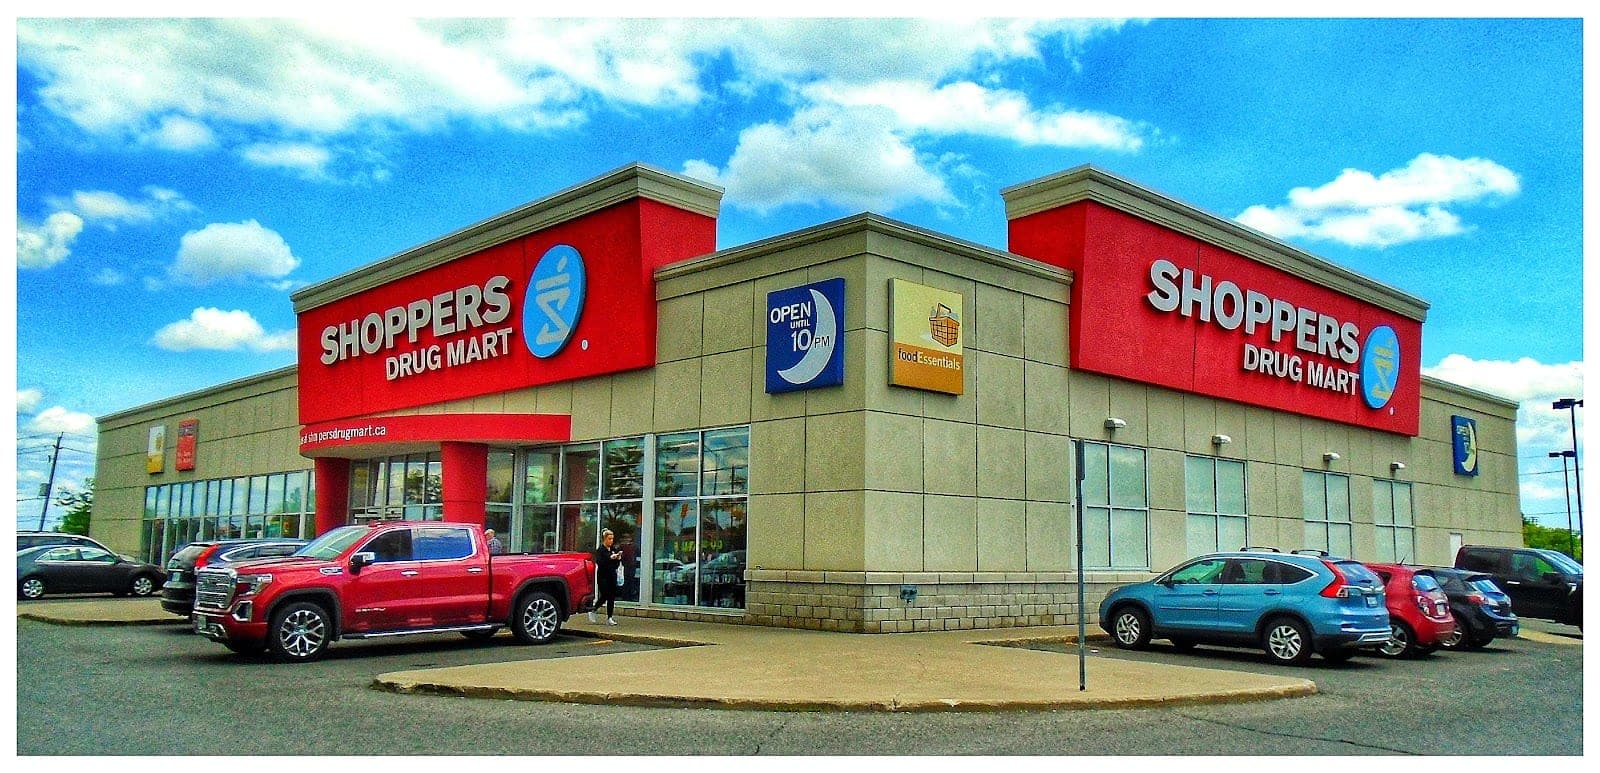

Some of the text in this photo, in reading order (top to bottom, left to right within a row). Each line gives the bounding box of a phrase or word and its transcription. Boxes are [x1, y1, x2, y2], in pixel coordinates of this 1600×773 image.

[320, 275, 511, 365] SHOPPERS
[770, 301, 811, 324] OPEN
[790, 319, 811, 329] UNTIL
[1147, 259, 1360, 364] SHOPPERS
[385, 327, 513, 381] DRUG MART
[791, 328, 830, 352] 10 PM
[898, 347, 961, 371] foodEssentials
[1243, 342, 1360, 396] DRUG MART
